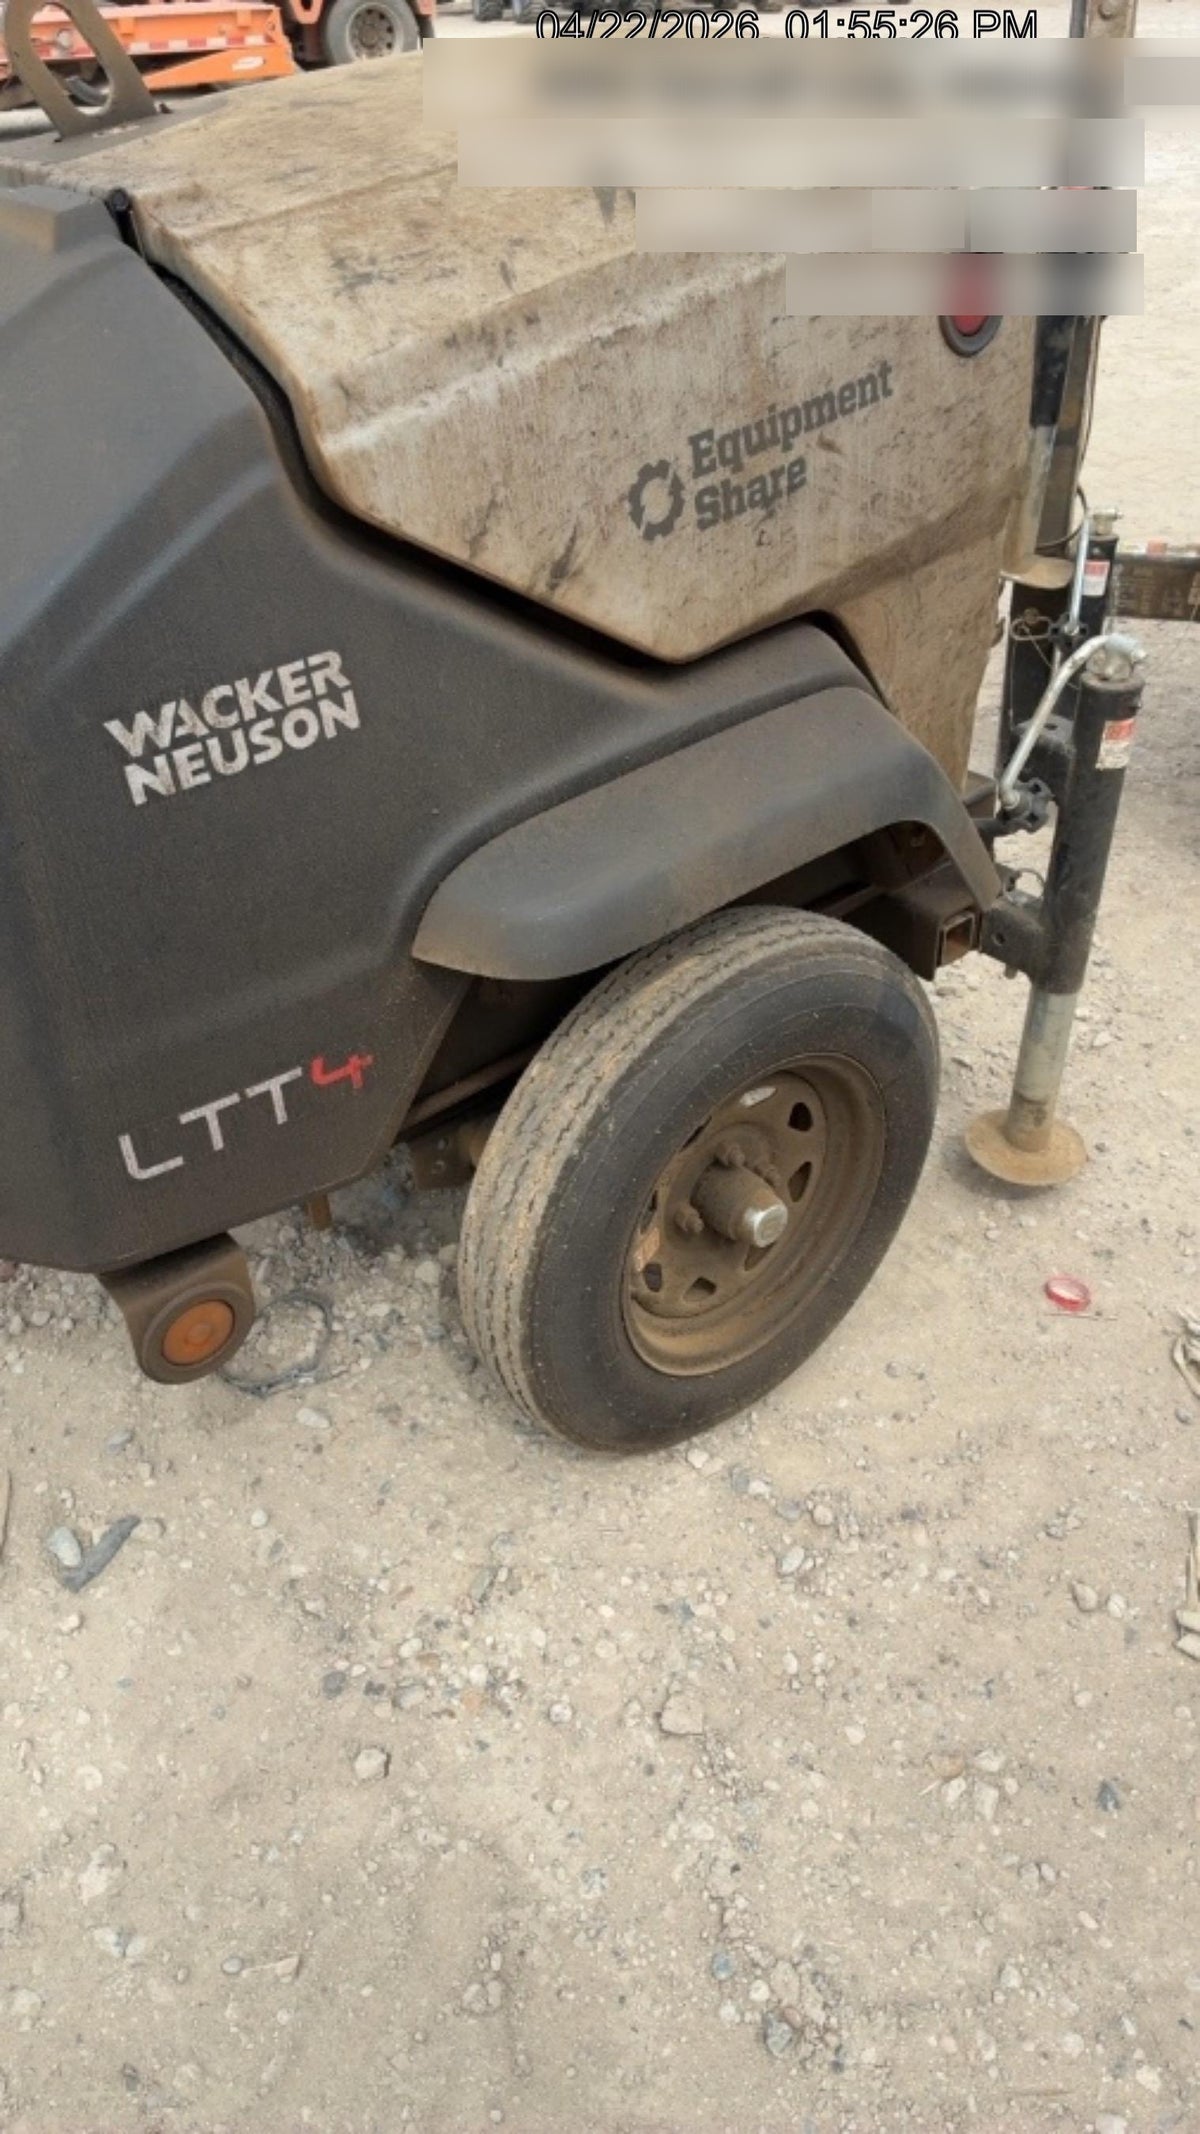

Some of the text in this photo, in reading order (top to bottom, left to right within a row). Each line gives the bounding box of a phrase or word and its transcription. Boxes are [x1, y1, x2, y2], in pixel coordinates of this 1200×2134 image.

[688, 360, 893, 479] Equipment
[694, 456, 807, 532] Share
[103, 650, 351, 757] WACKER
[123, 690, 360, 806] NEUSON
